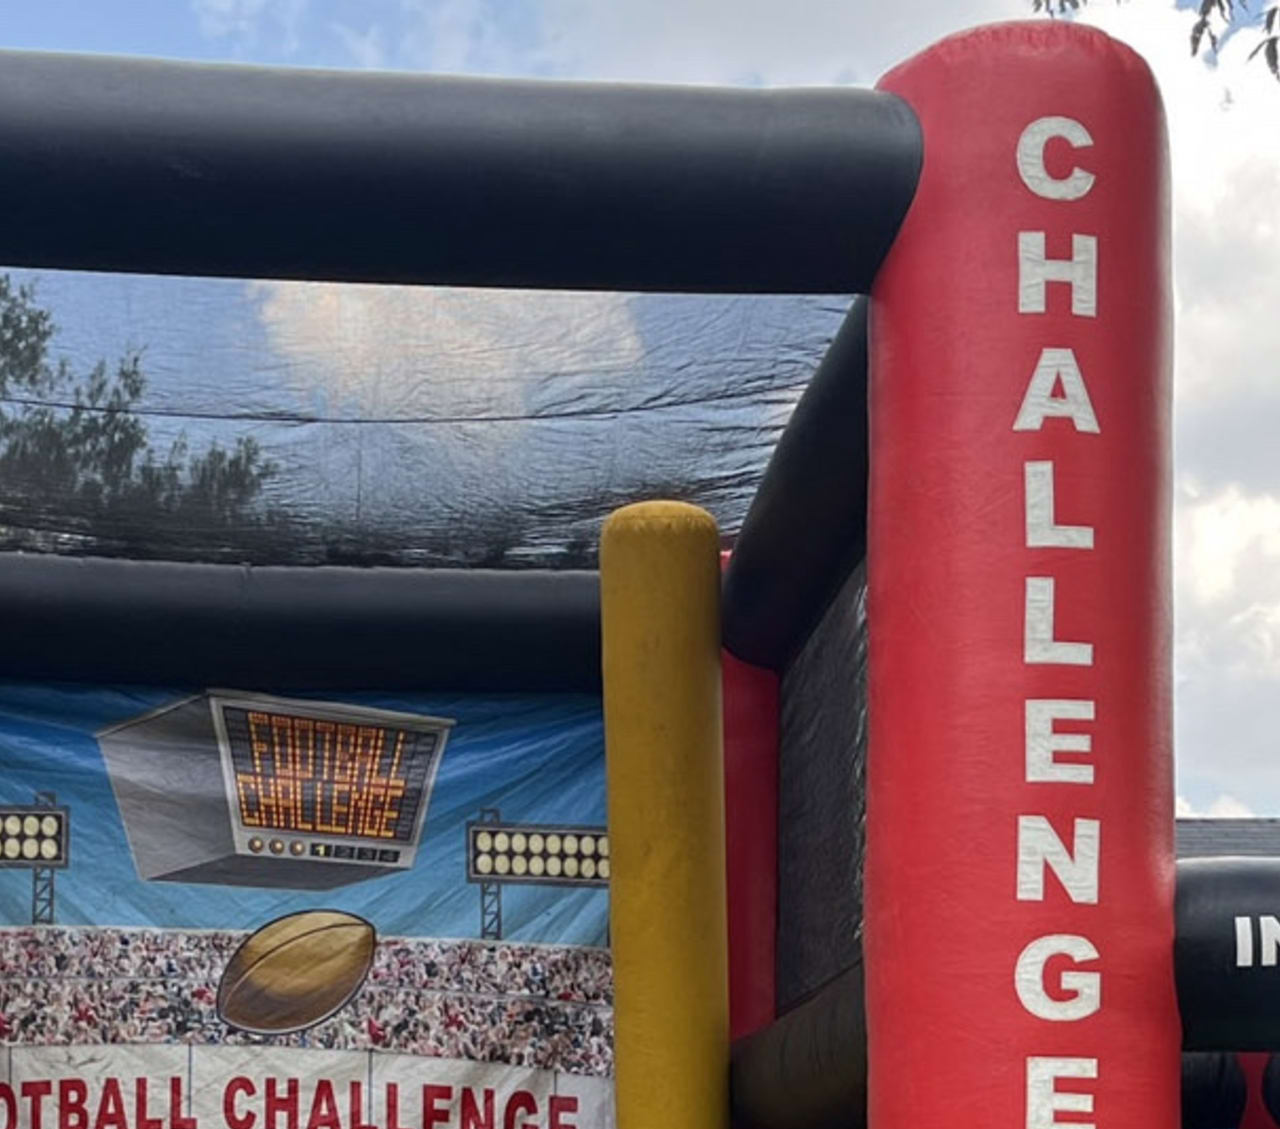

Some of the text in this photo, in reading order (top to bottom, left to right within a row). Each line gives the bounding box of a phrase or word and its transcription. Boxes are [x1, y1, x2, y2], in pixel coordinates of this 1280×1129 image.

[248, 712, 406, 787] FOOTBALL
[237, 773, 404, 837] CHALLENGE
[315, 844, 325, 857] 1
